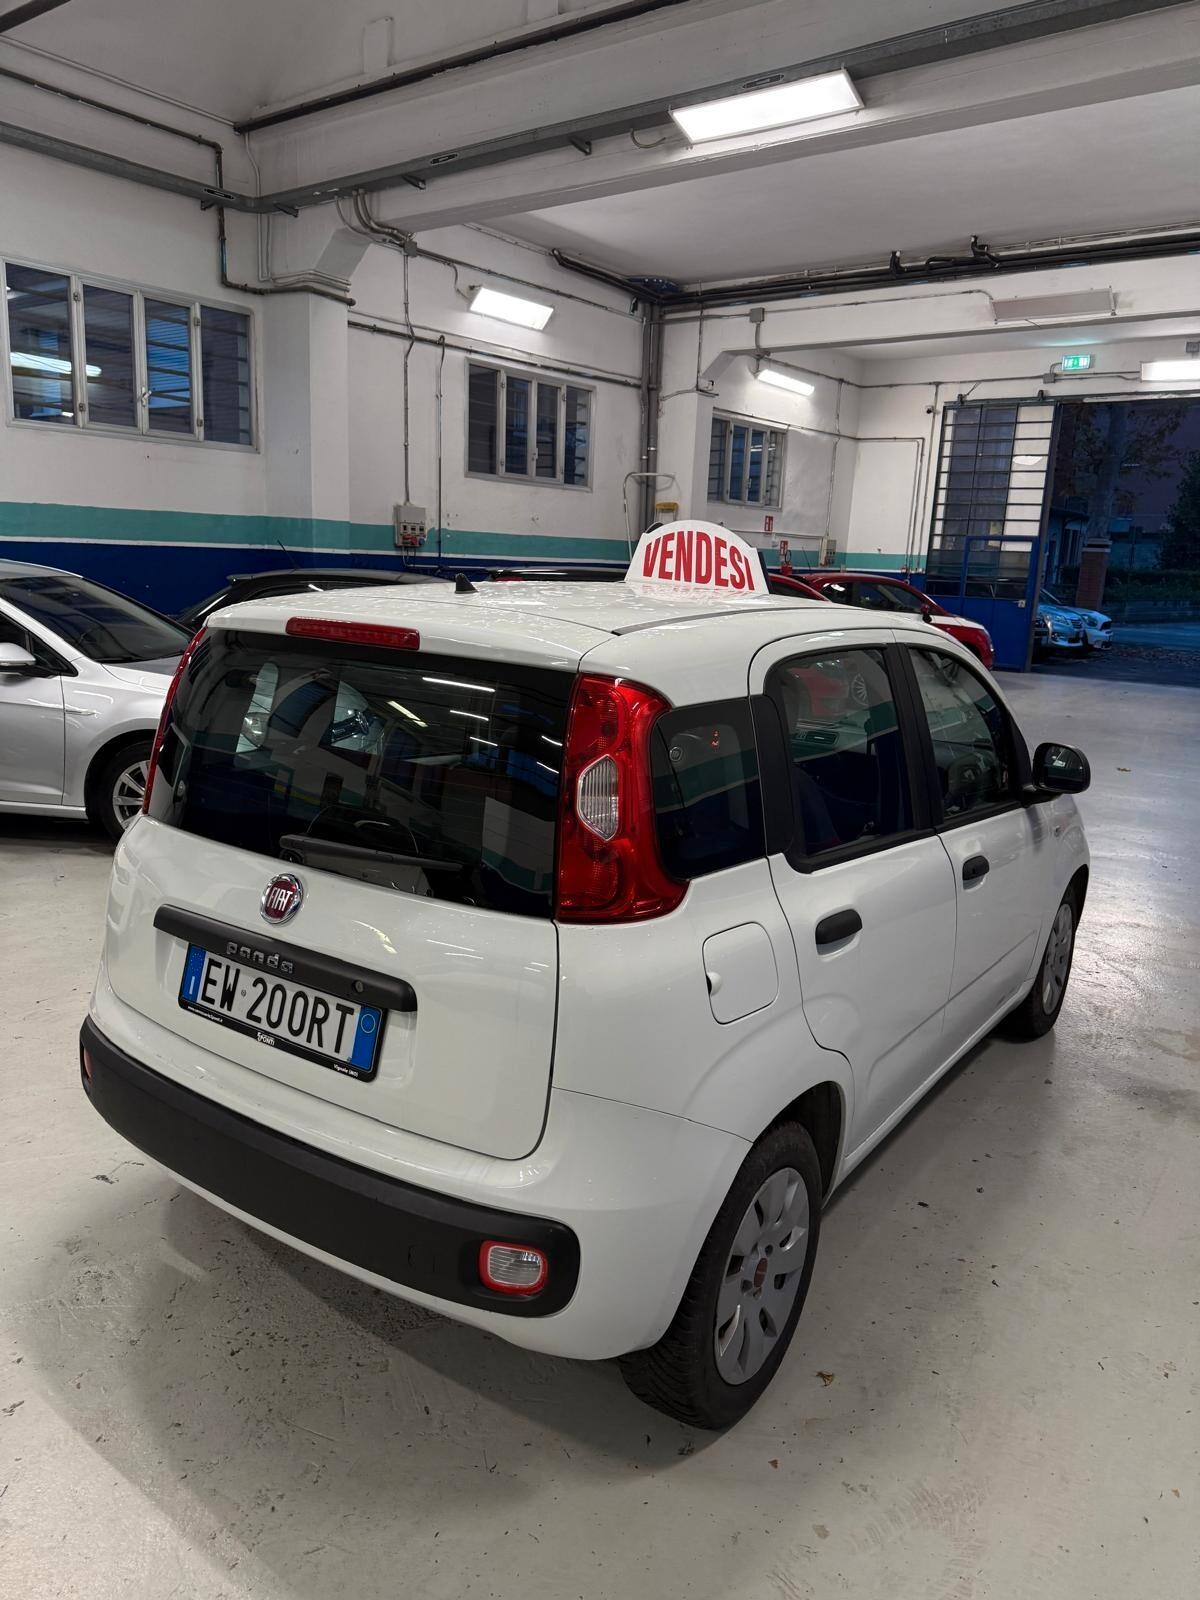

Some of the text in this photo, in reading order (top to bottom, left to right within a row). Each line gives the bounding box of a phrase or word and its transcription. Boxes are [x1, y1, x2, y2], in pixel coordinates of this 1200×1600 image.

[643, 531, 755, 590] VENDESI
[267, 887, 293, 911] FIAT
[226, 942, 294, 974] panda
[201, 958, 354, 1053] EW 200RT
